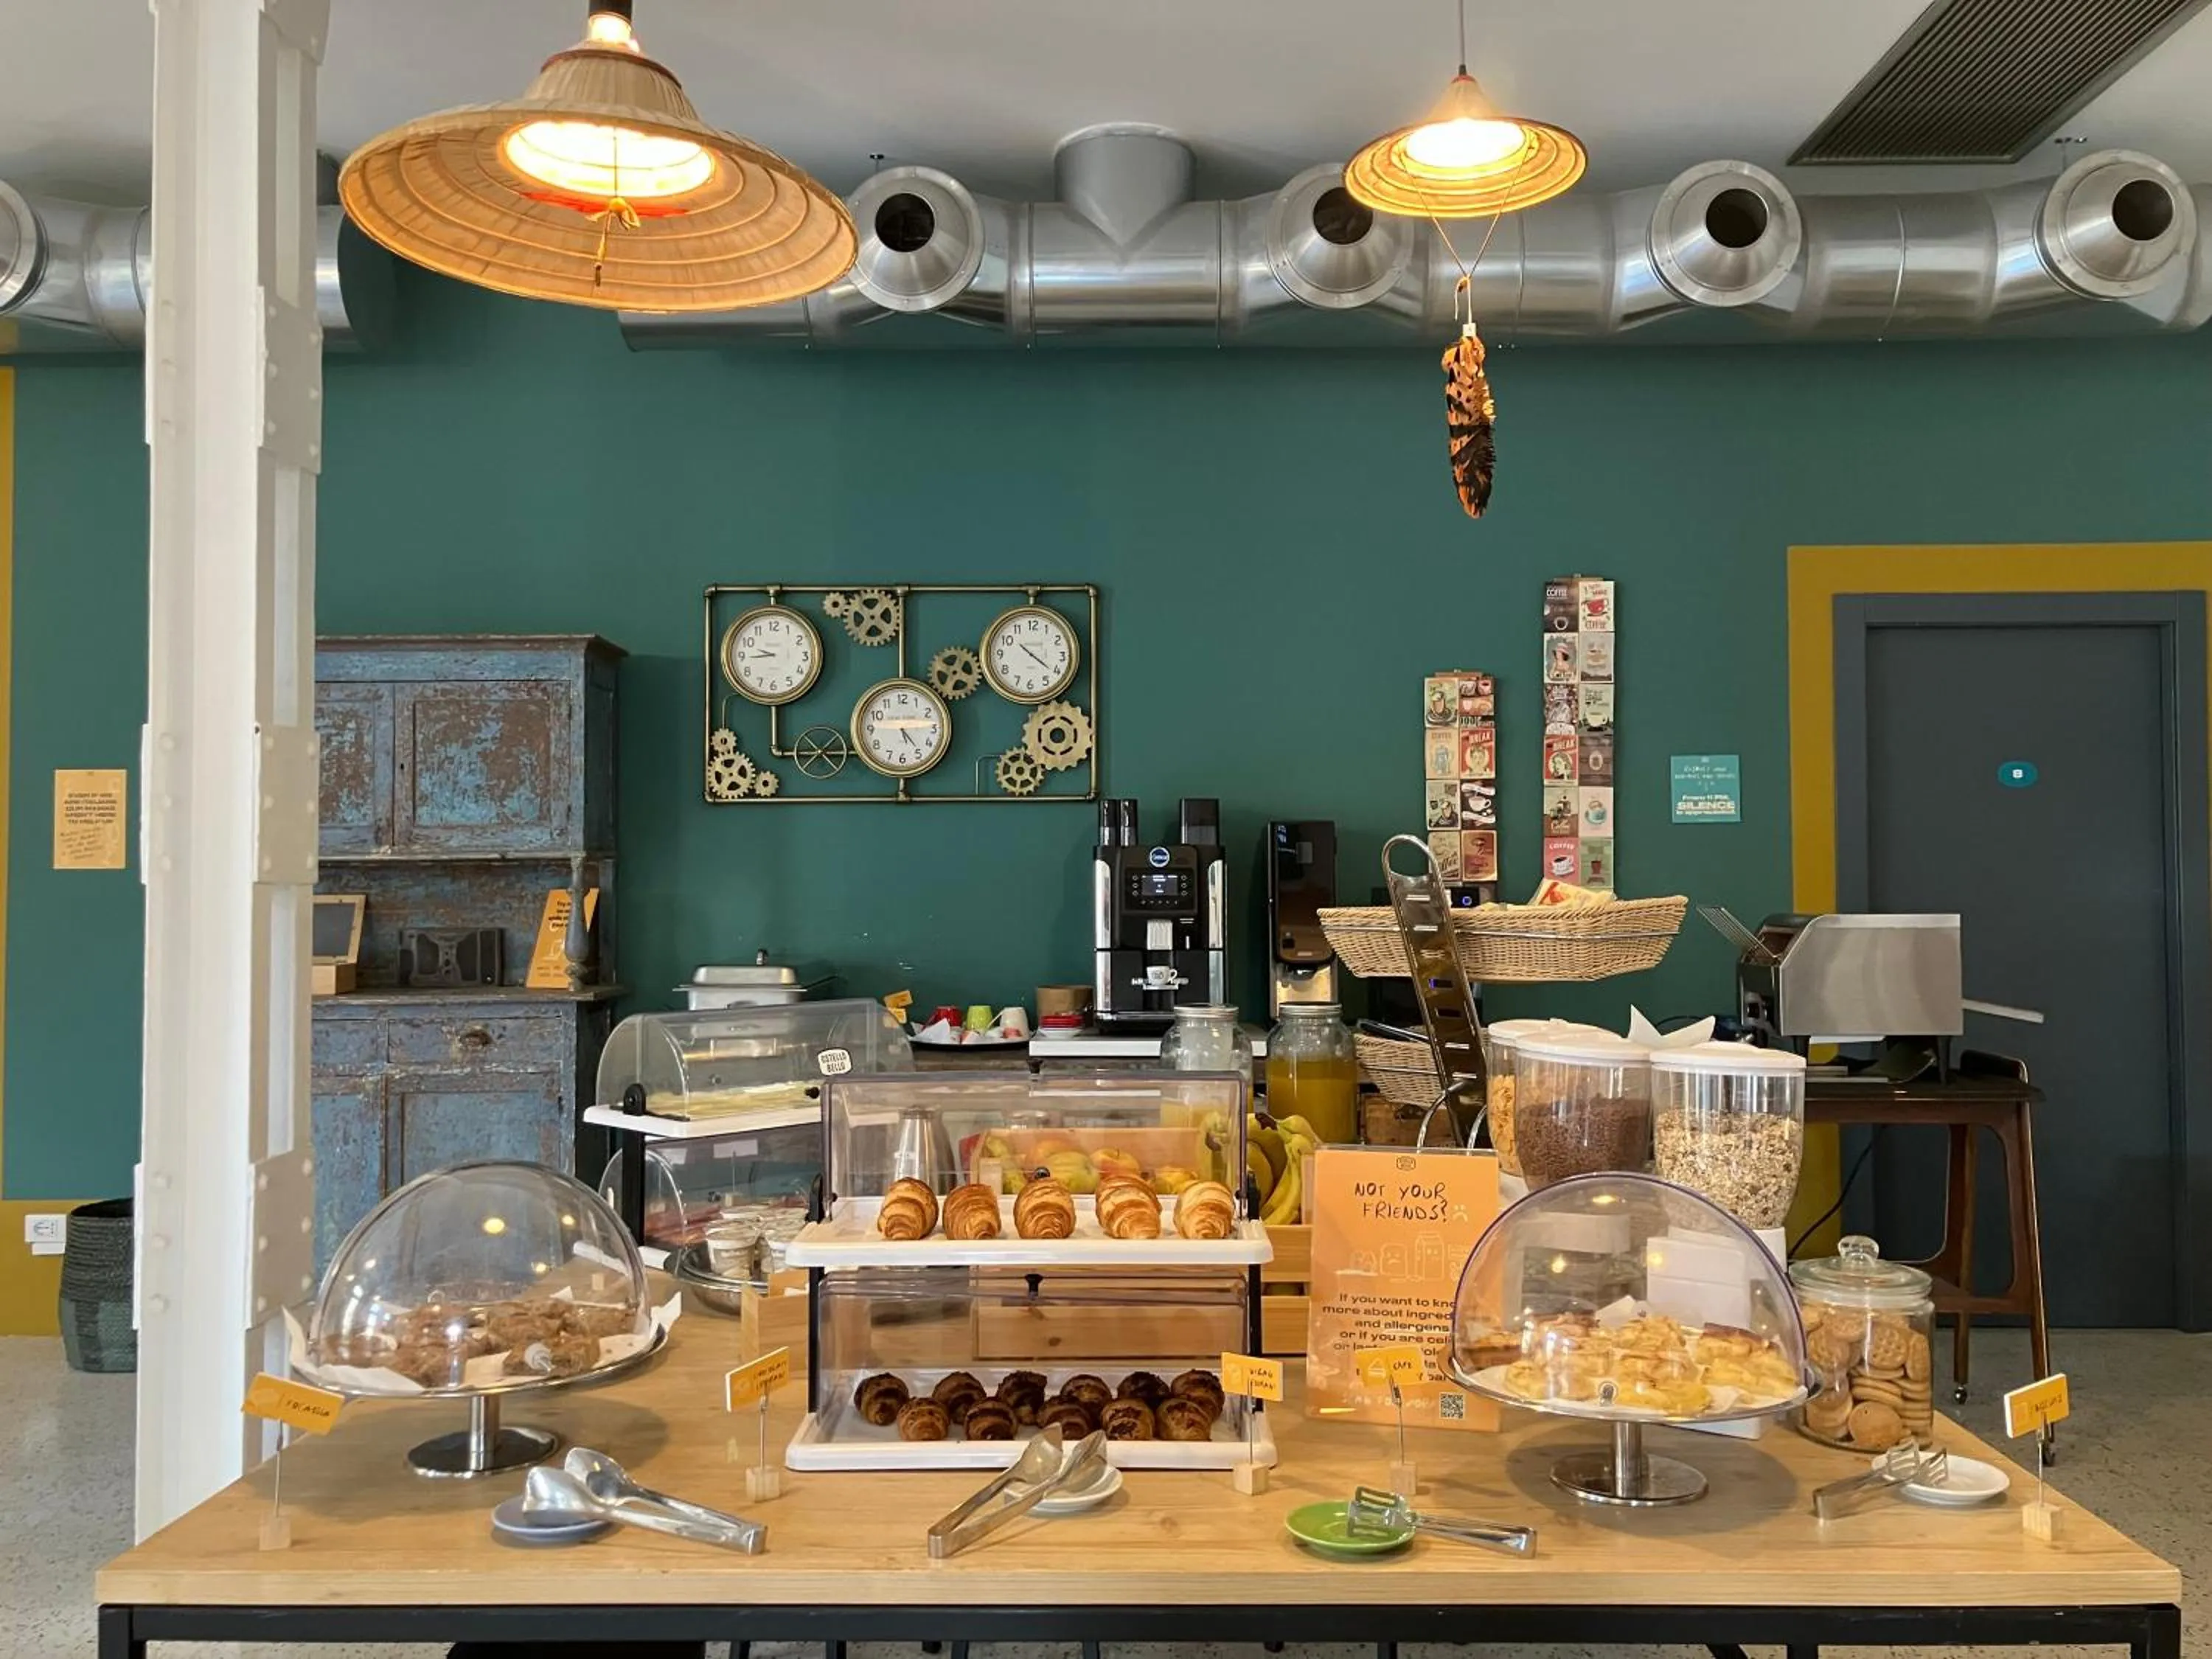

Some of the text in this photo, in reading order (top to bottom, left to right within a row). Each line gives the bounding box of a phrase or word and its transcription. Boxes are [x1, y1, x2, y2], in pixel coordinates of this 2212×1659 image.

[754, 625, 762, 636] 11
[768, 621, 779, 632] 12
[785, 625, 790, 635] 1
[1014, 625, 1021, 634] 11
[1028, 620, 1039, 631] 12
[1045, 625, 1048, 634] 1
[742, 636, 754, 647] 10
[796, 635, 803, 646] 2
[1002, 635, 1014, 646] 10
[1054, 635, 1061, 646] 2
[738, 651, 745, 661] 9
[801, 651, 809, 661] 3
[996, 649, 1004, 659] 9
[1059, 651, 1065, 662] 3
[744, 666, 751, 677] 8
[796, 665, 804, 675] 4
[1001, 664, 1009, 675] 8
[1054, 664, 1060, 675] 4
[757, 677, 763, 687] 7
[770, 680, 777, 691] 6
[785, 676, 793, 686] 5
[1014, 675, 1021, 686] 7
[1026, 679, 1034, 689] 6
[1042, 675, 1049, 686] 5
[883, 698, 890, 708] 11
[897, 694, 908, 704] 12
[914, 698, 918, 708] 1
[871, 710, 884, 720] 10
[924, 708, 931, 718] 2
[866, 725, 874, 735] 9
[930, 724, 937, 734] 3
[872, 740, 880, 750] 8
[925, 737, 933, 748] 4
[886, 750, 893, 760] 7
[899, 753, 906, 764] 6
[915, 748, 922, 759] 5
[1354, 1182, 1446, 1201] NOT YOUR
[1363, 1199, 1447, 1222] FRIENDS?
[1340, 1293, 1348, 1302] If
[1352, 1295, 1377, 1304] you
[1380, 1296, 1413, 1306] want
[1416, 1298, 1430, 1307] to
[1322, 1305, 1360, 1315] more
[1363, 1307, 1403, 1317] about
[1354, 1320, 1381, 1328] and
[1359, 1330, 1368, 1339] if
[1371, 1333, 1396, 1341] you
[1399, 1335, 1424, 1343] are
